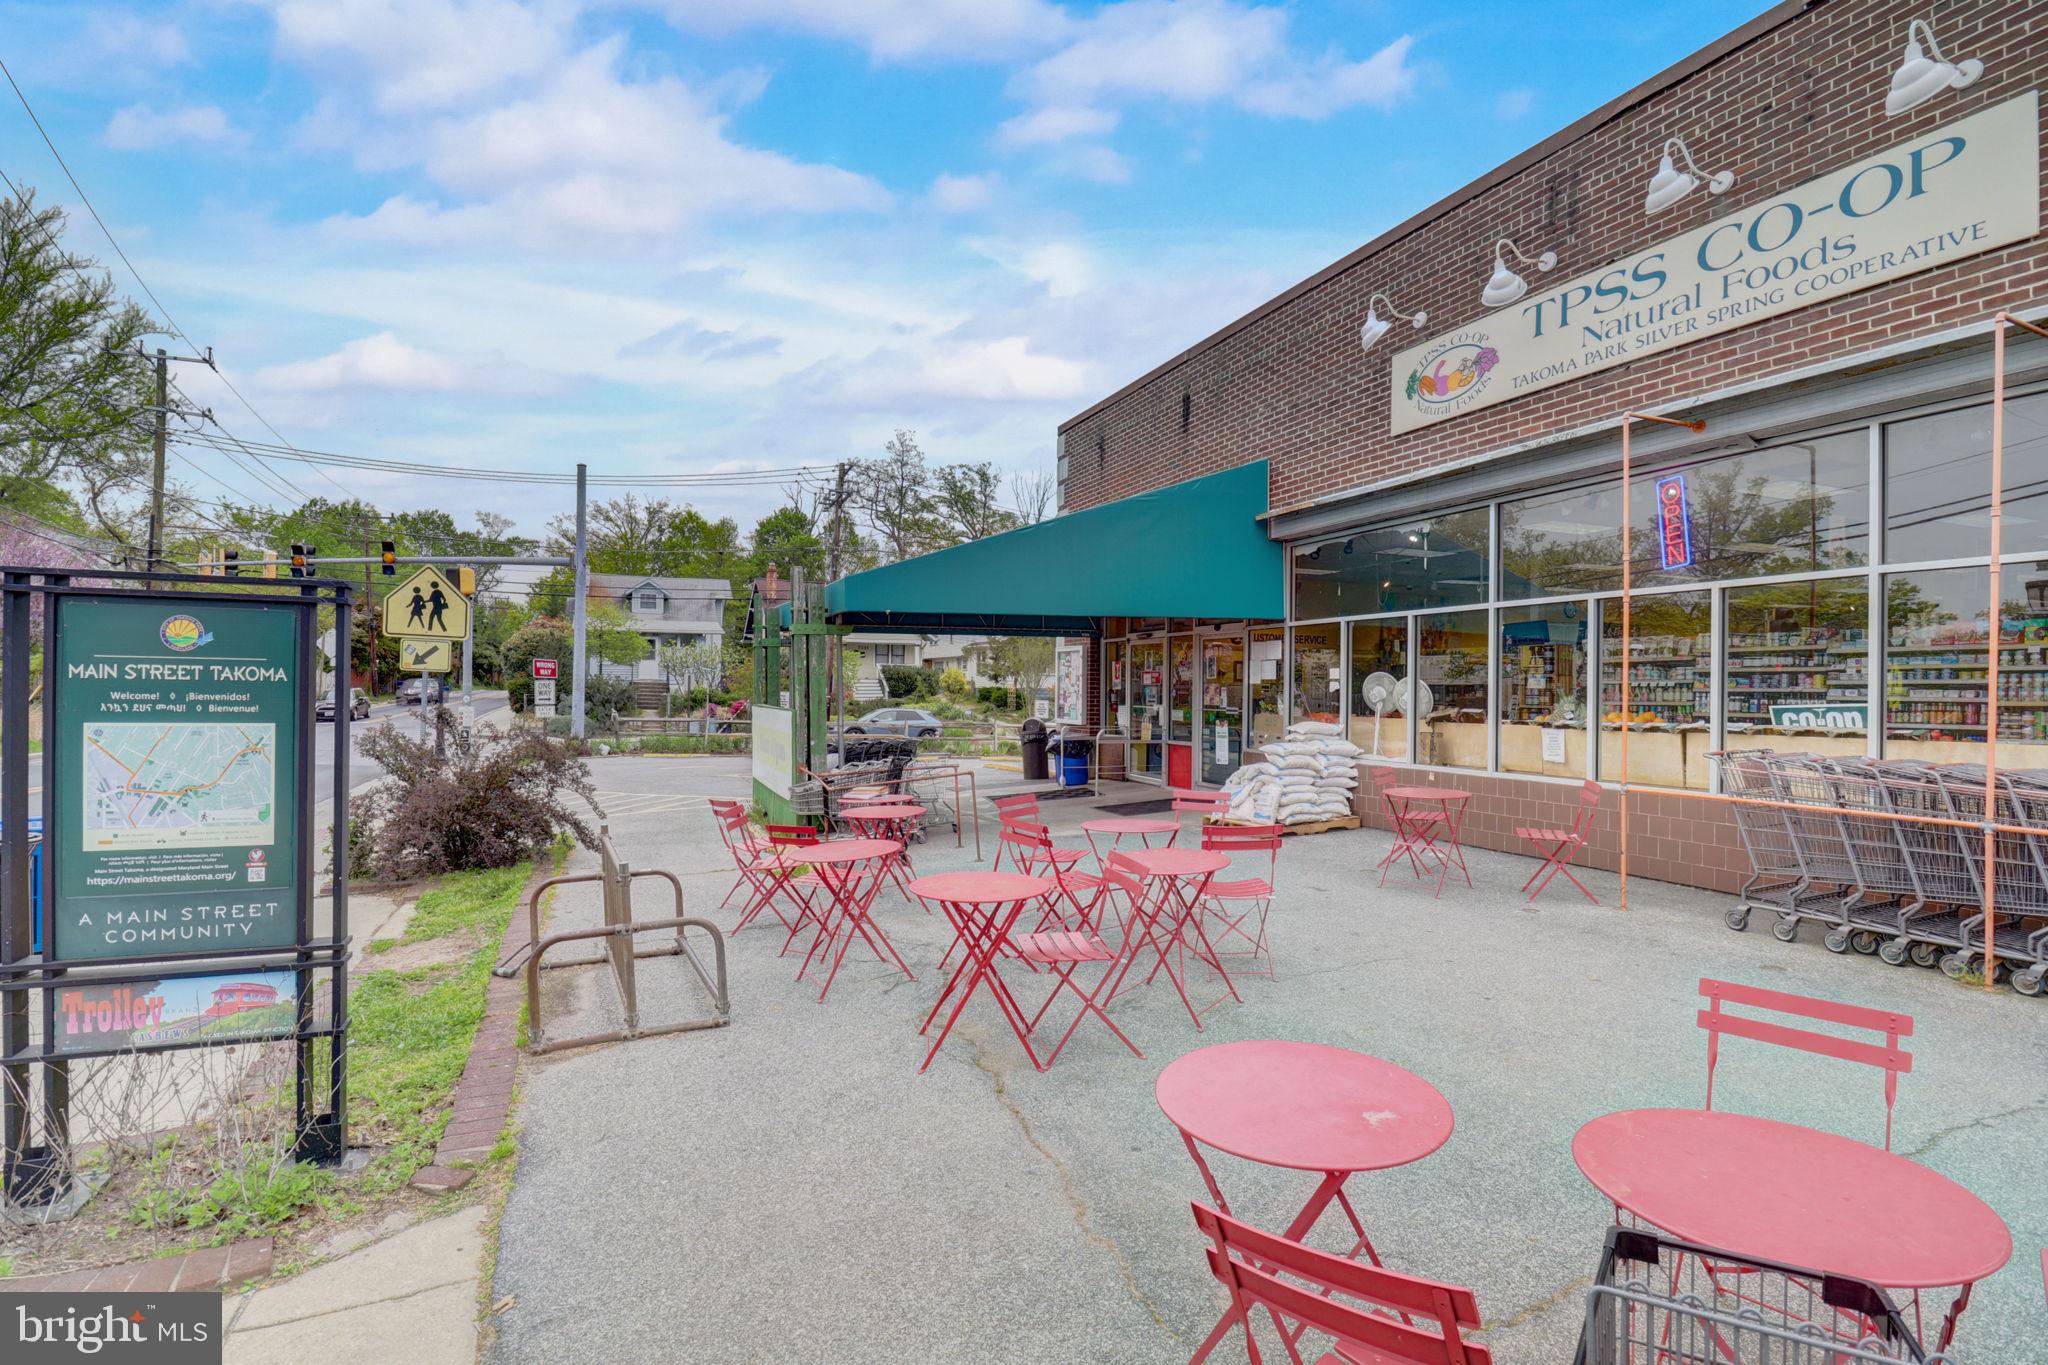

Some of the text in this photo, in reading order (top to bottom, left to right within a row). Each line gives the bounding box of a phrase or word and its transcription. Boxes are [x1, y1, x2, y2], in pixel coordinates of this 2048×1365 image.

[1522, 136, 1967, 339] TPSS CO-OP
[1581, 234, 1857, 349] Natural Foods
[1512, 220, 1988, 390] TAKOMA PARK SILVER SPRING COOPERATIVE
[1418, 331, 1489, 368] TPSS CO-OP
[1414, 376, 1492, 416] Natural Foods
[1661, 482, 1686, 565] OPEN
[1295, 634, 1327, 645] SERVICE
[68, 663, 288, 682] MAIN STREET TAKOMA
[110, 691, 250, 702] Welcome! ¡Bienvenidos!
[537, 682, 552, 690] ONE
[208, 704, 259, 713] Bienvenue!
[86, 871, 237, 886] https://mainstreettakoma.org/
[78, 903, 278, 926] A MAIN STREET
[105, 922, 253, 943] COMMUNITY
[62, 988, 165, 1035] Trolley
[131, 1028, 190, 1042] CASHEWS
